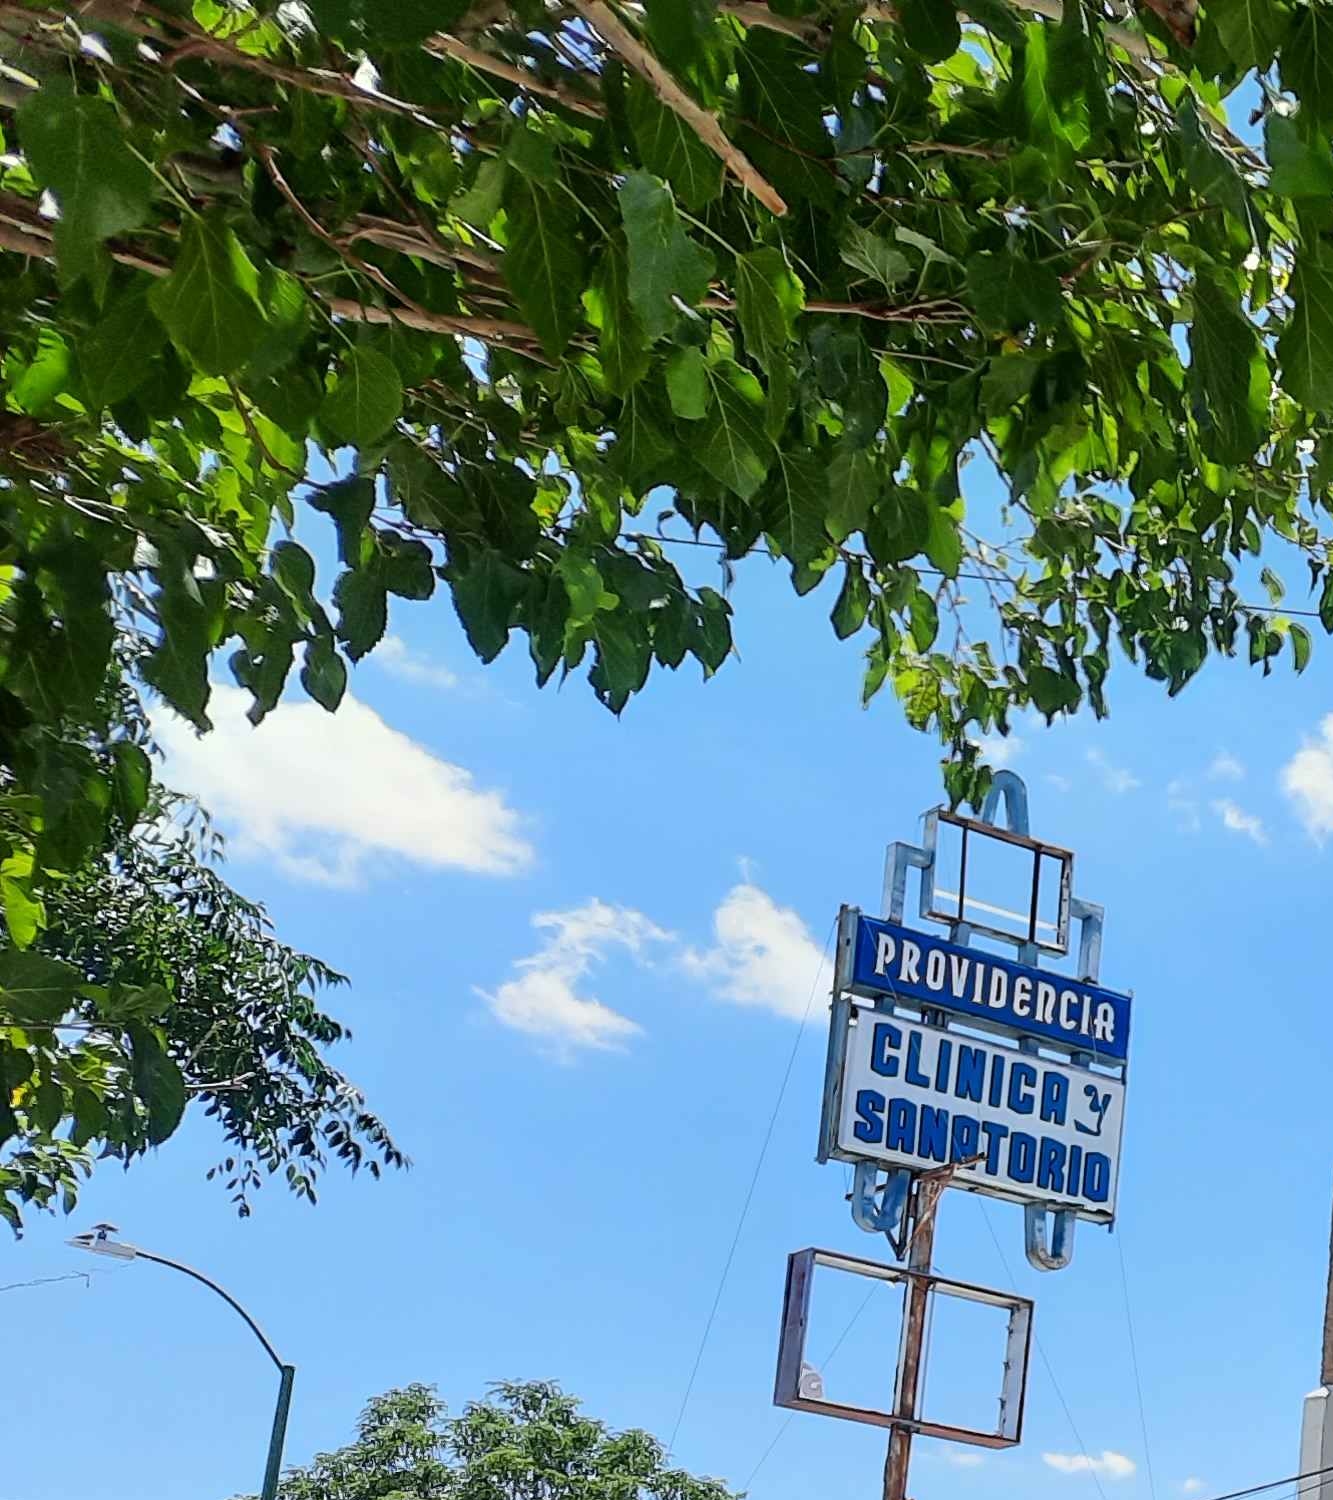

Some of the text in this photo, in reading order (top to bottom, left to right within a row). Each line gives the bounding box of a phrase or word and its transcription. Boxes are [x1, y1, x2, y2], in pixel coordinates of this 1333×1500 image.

[873, 931, 1117, 1044] PROVIDENCIA
[870, 1021, 1070, 1127] CLINICA
[853, 1088, 1113, 1203] SANATORIO
